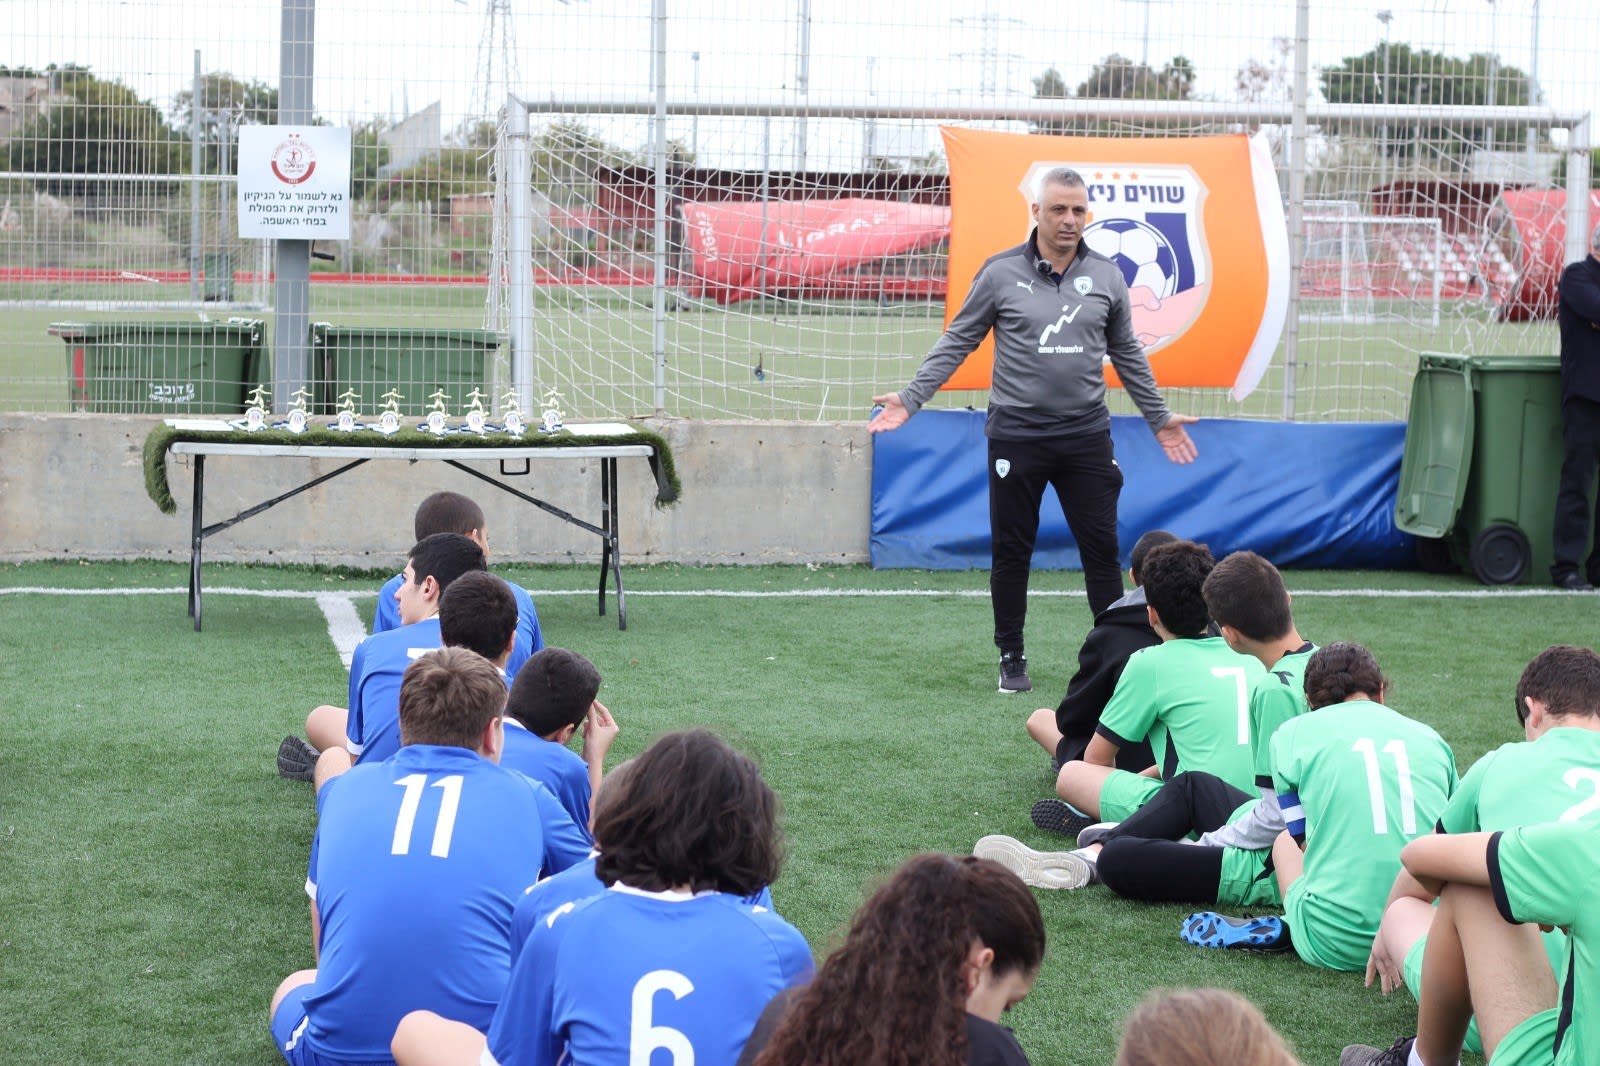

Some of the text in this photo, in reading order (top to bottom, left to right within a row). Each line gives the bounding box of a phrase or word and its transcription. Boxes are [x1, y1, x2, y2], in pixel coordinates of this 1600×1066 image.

[244, 190, 343, 202] נא לשמור על הניקיון
[248, 203, 338, 215] ולזרוק את הפסולת
[1124, 185, 1185, 204] שווים
[259, 216, 327, 226] בפחי האשפה.
[154, 385, 184, 394] דולב
[1210, 667, 1249, 745] 7
[1352, 737, 1417, 835] 11
[1562, 766, 1600, 822] 2
[391, 773, 464, 859] 11
[629, 969, 695, 1066] 6
